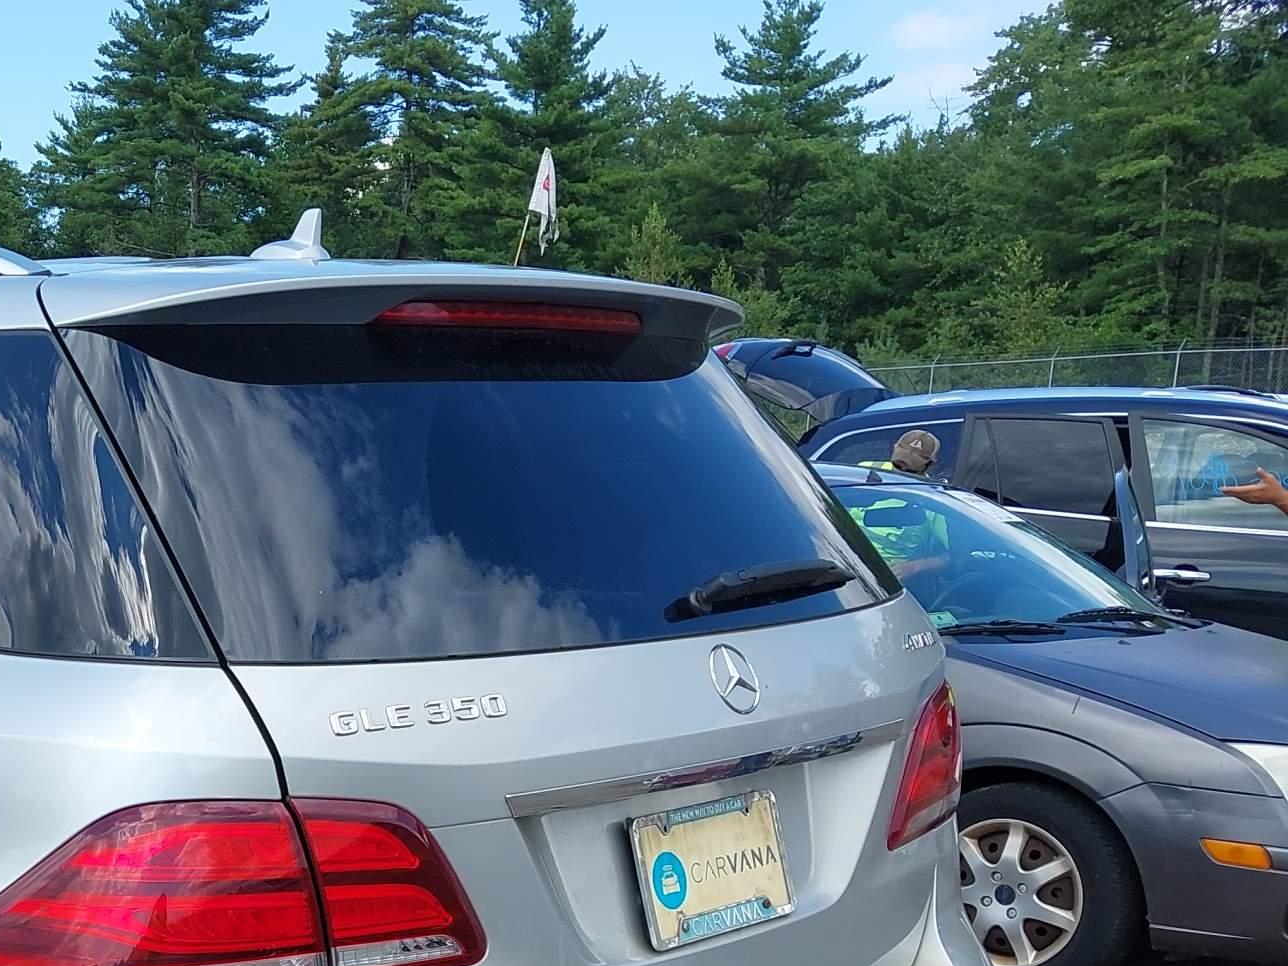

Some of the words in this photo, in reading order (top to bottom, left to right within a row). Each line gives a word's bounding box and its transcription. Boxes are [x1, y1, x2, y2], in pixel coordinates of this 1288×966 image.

[329, 704, 415, 737] GLE
[423, 693, 508, 725] 350
[670, 812, 682, 822] THE
[682, 809, 695, 820] NEW
[695, 806, 707, 817] WAY
[706, 805, 714, 816] TO
[729, 799, 743, 810] CAR
[690, 844, 778, 884] CARVANA
[691, 903, 764, 937] CARVANA
